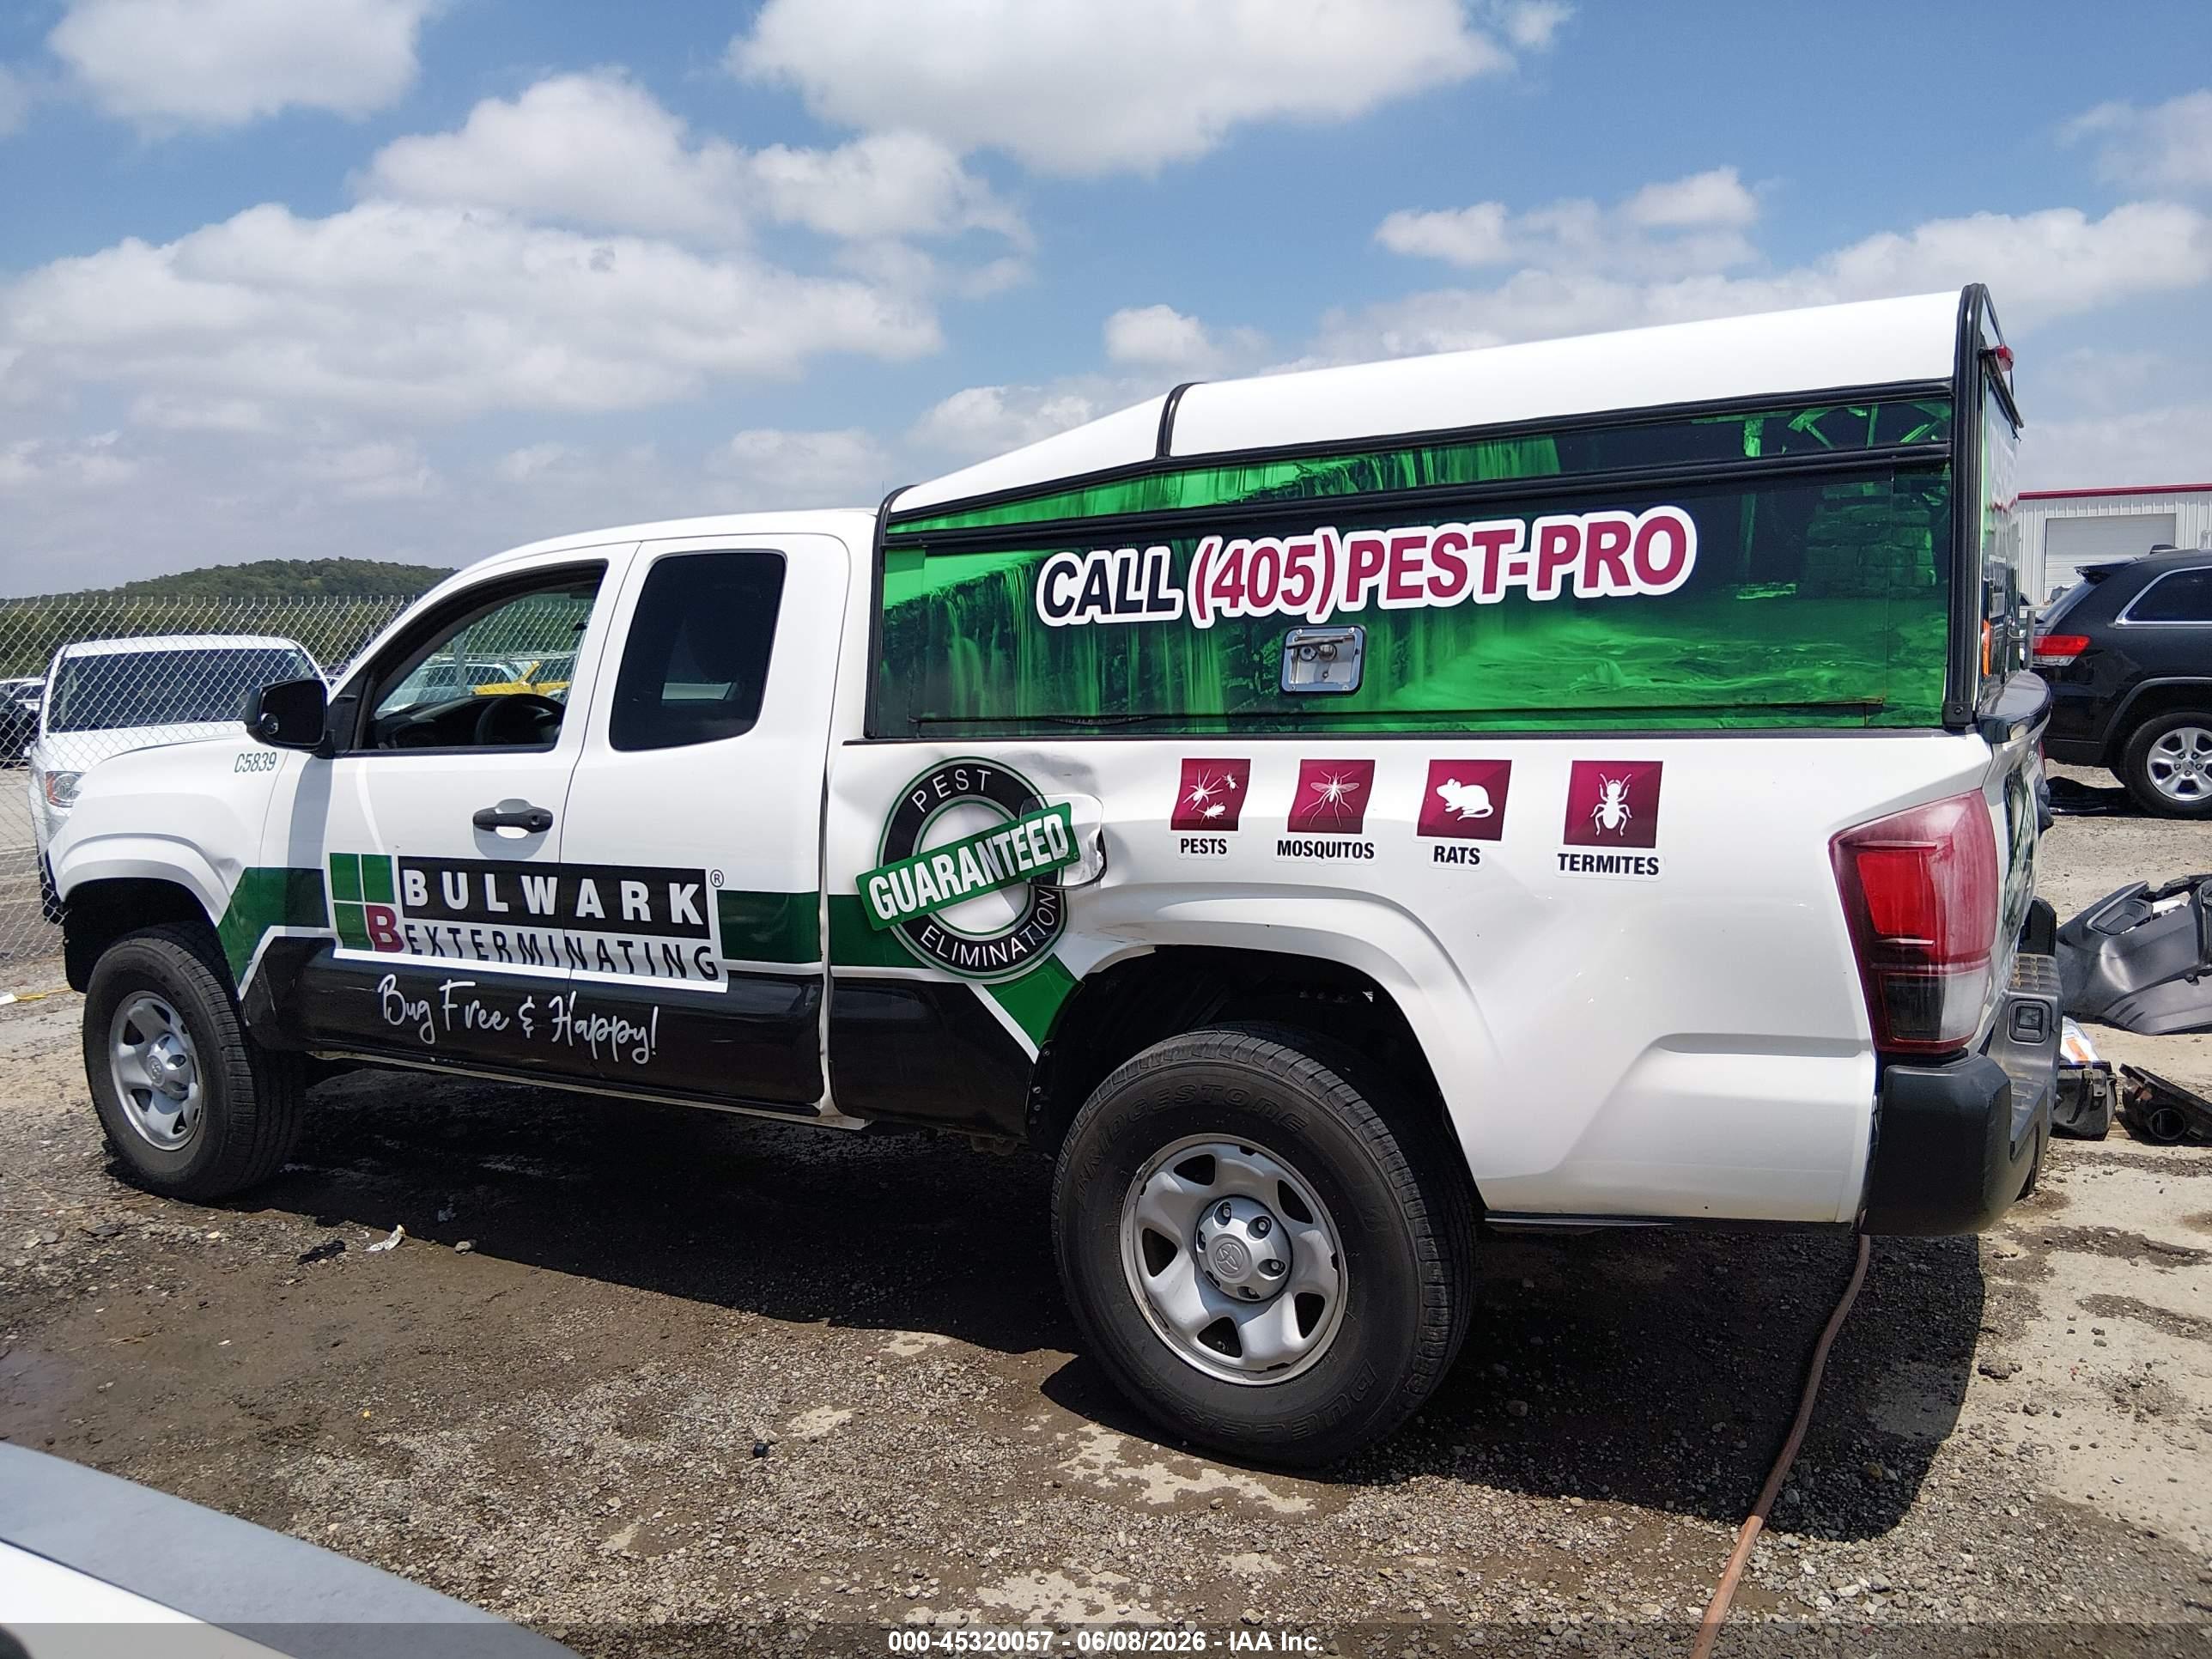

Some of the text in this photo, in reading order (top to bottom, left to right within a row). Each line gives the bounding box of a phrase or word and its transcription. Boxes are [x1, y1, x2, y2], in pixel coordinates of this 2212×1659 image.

[1042, 546, 1178, 617] CALL
[234, 752, 276, 774] C5839
[911, 769, 992, 813] PEST
[868, 813, 1070, 921] GUARANTEED
[1180, 838, 1227, 855] PESTS
[1277, 840, 1375, 860] MOSQUITOS
[1433, 845, 1480, 866] RATS
[1558, 853, 1660, 877] TERMITES
[920, 890, 1058, 967] ELIMINATION
[404, 924, 720, 981] EXTERMINATING
[377, 973, 436, 1044] Bug
[439, 979, 510, 1031] Free
[548, 990, 659, 1065] Happy!
